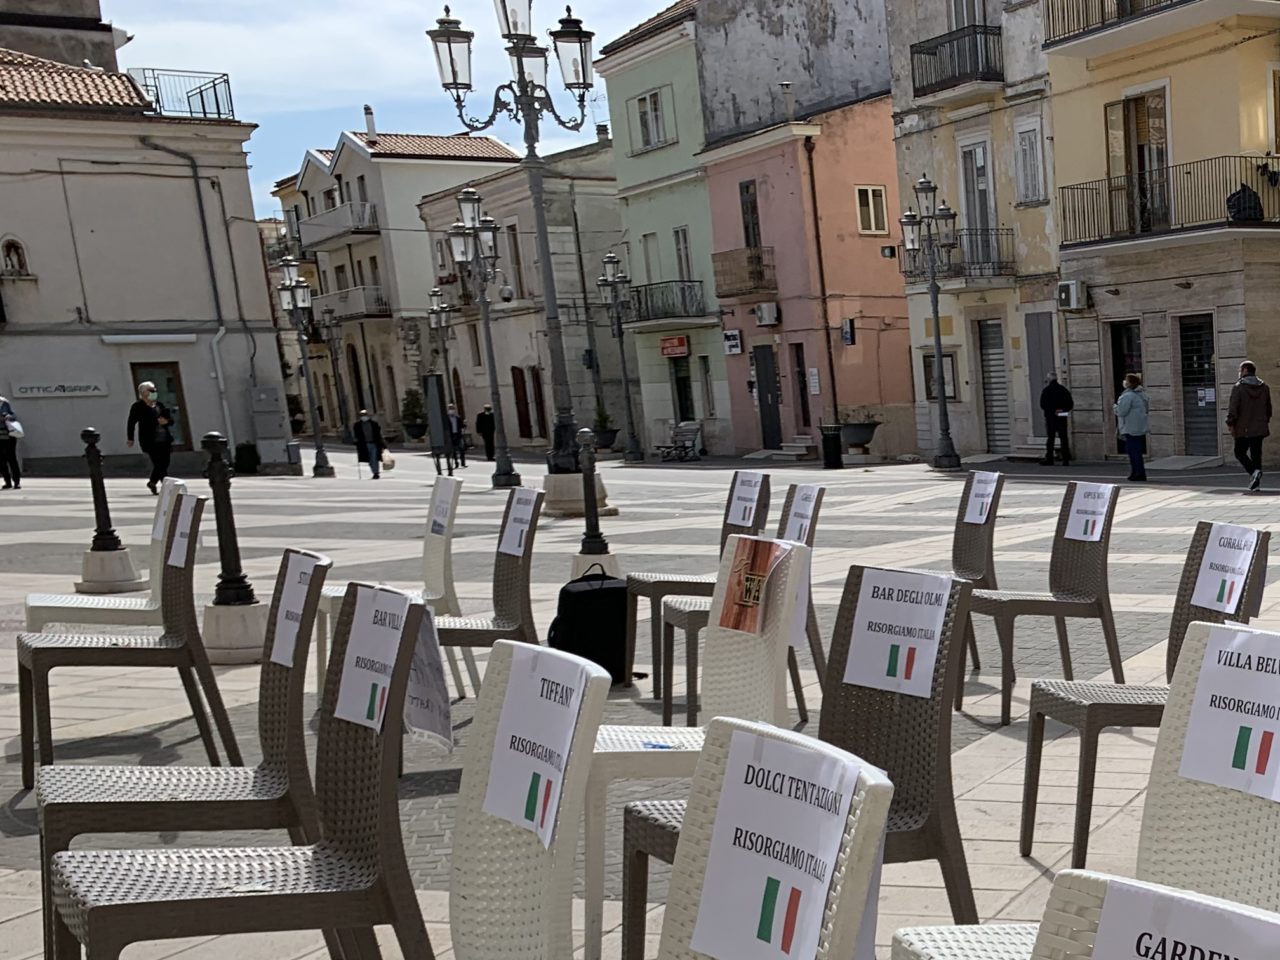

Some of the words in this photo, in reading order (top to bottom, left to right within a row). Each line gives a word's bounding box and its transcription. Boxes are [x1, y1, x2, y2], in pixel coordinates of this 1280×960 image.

[18, 384, 60, 394] OTTICA
[871, 586, 896, 602] BAR
[896, 588, 923, 605] DEGLI
[924, 591, 944, 607] OLMI
[373, 609, 388, 627] BAR
[866, 620, 917, 640] RISORGIAMO
[1216, 650, 1252, 671] VILLA
[540, 677, 575, 708] TIFFANY
[1209, 694, 1276, 719] RISORGIAMO
[509, 734, 557, 769] RISORGIAMO
[743, 764, 784, 795] DOLCI
[786, 776, 844, 816] TENTAZIONI
[732, 827, 806, 871] RISORGIAMO
[804, 854, 828, 884] ITALIA
